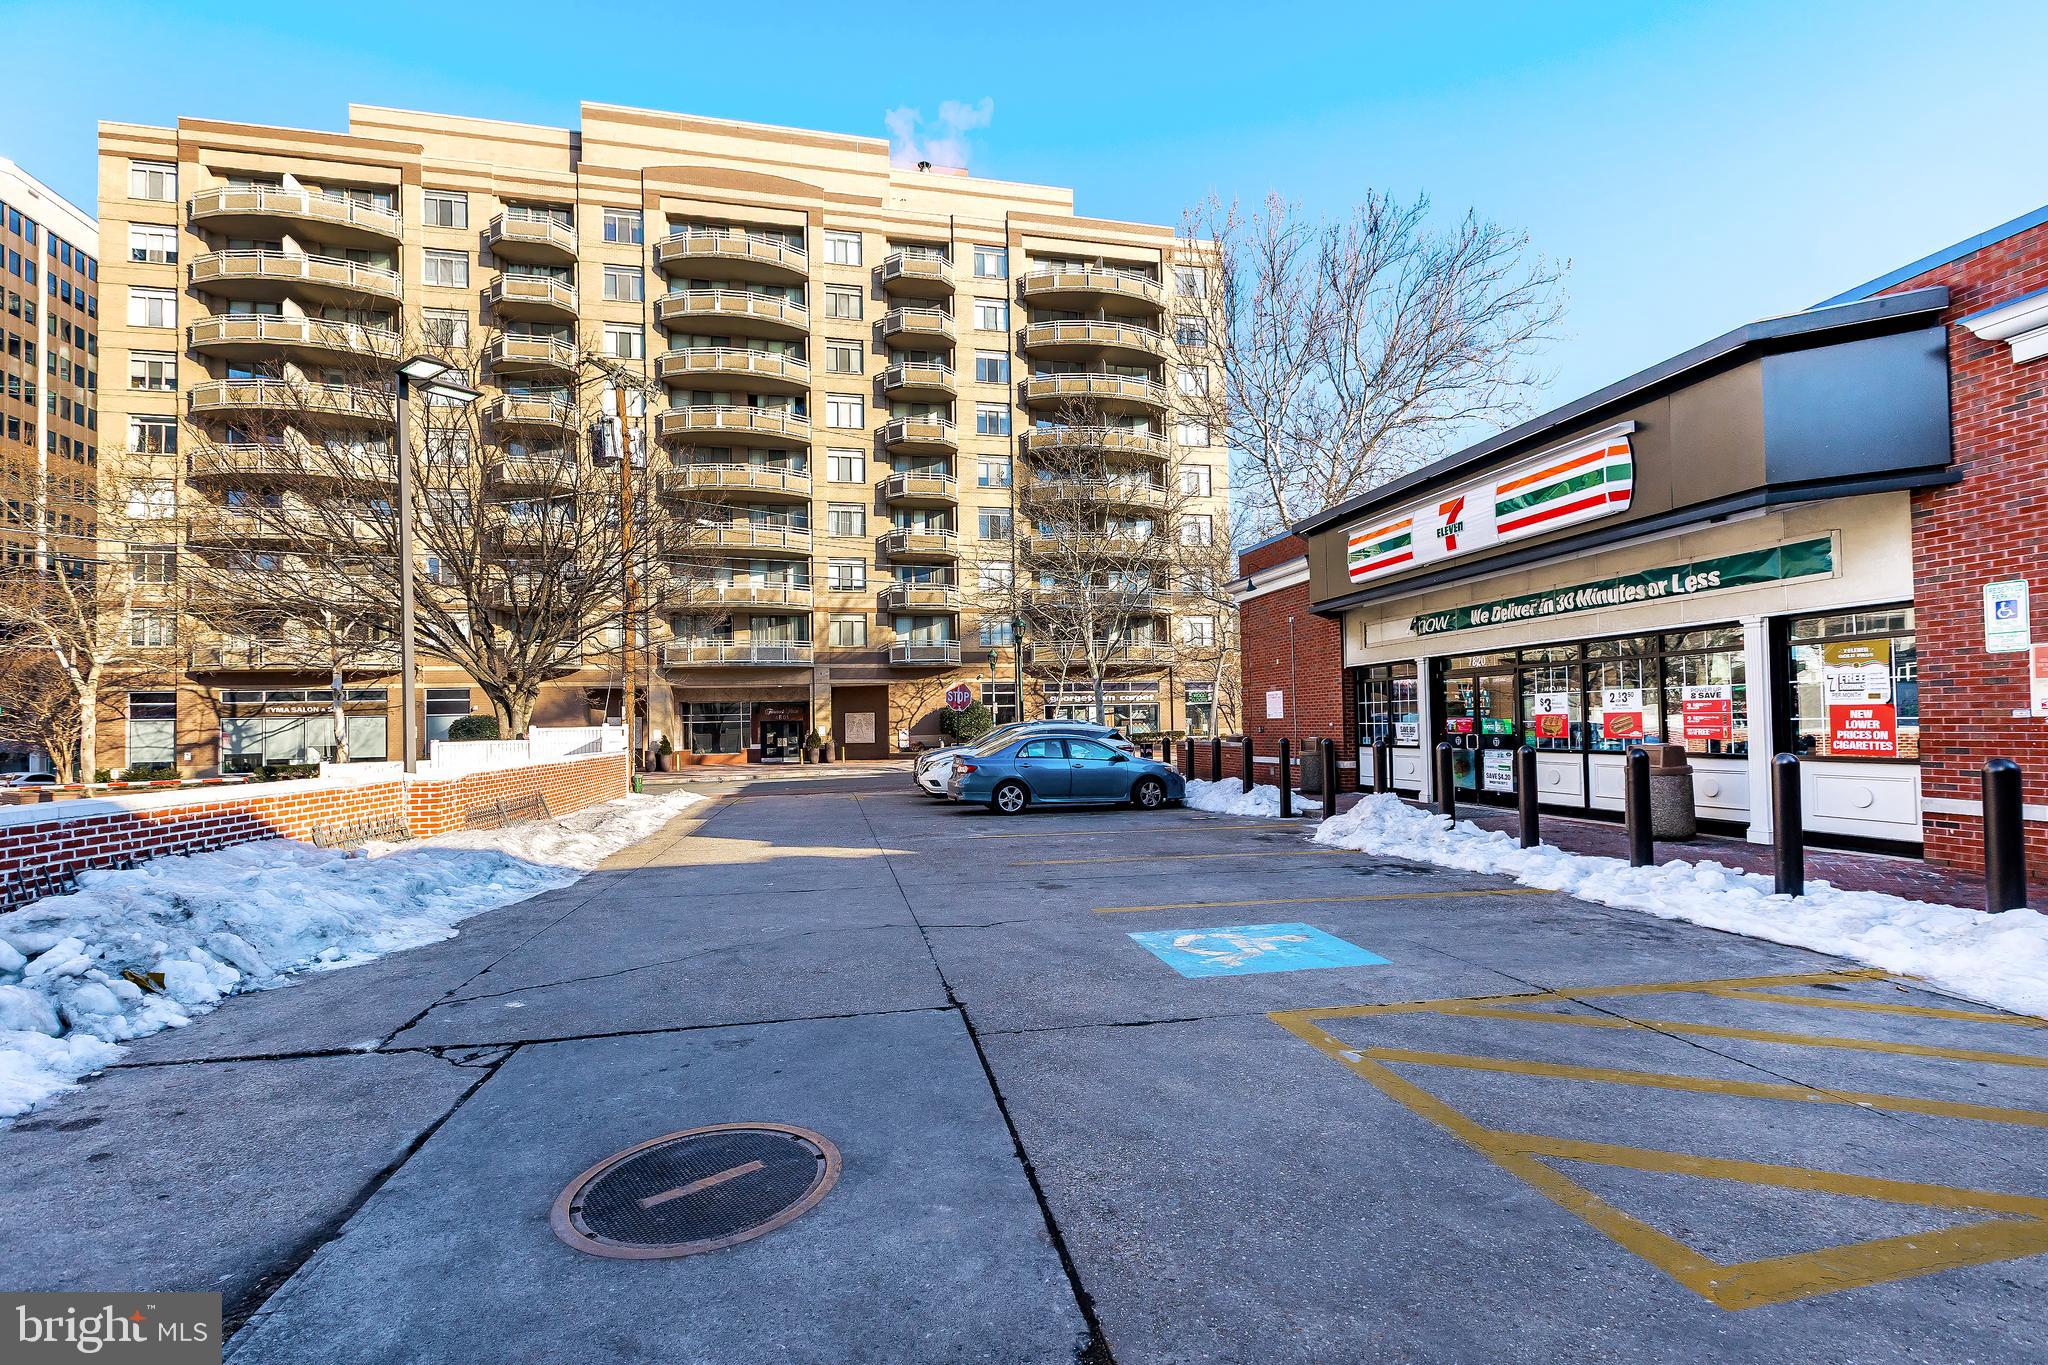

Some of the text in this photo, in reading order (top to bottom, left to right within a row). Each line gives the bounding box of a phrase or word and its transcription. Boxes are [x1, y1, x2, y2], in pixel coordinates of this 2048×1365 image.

[1439, 496, 1465, 551] 7
[1470, 609, 1489, 625] We
[1491, 602, 1538, 622] Deliver
[1538, 599, 1554, 614] in
[1556, 594, 1575, 612] 30
[1576, 584, 1646, 608] Minutes
[1648, 580, 1668, 597] or
[1672, 570, 1721, 594] Less
[1468, 656, 1486, 668] 7820
[1838, 673, 1866, 684] FREE
[947, 691, 970, 702] STOP
[1050, 694, 1155, 703] gorgetwn carpet
[1609, 692, 1615, 703] 2
[1540, 697, 1552, 712] $3
[1849, 709, 1873, 719] NEW
[1845, 720, 1881, 729] LOWER
[1836, 730, 1889, 740] PRICES ON
[1833, 740, 1894, 751] CIGARETTES
